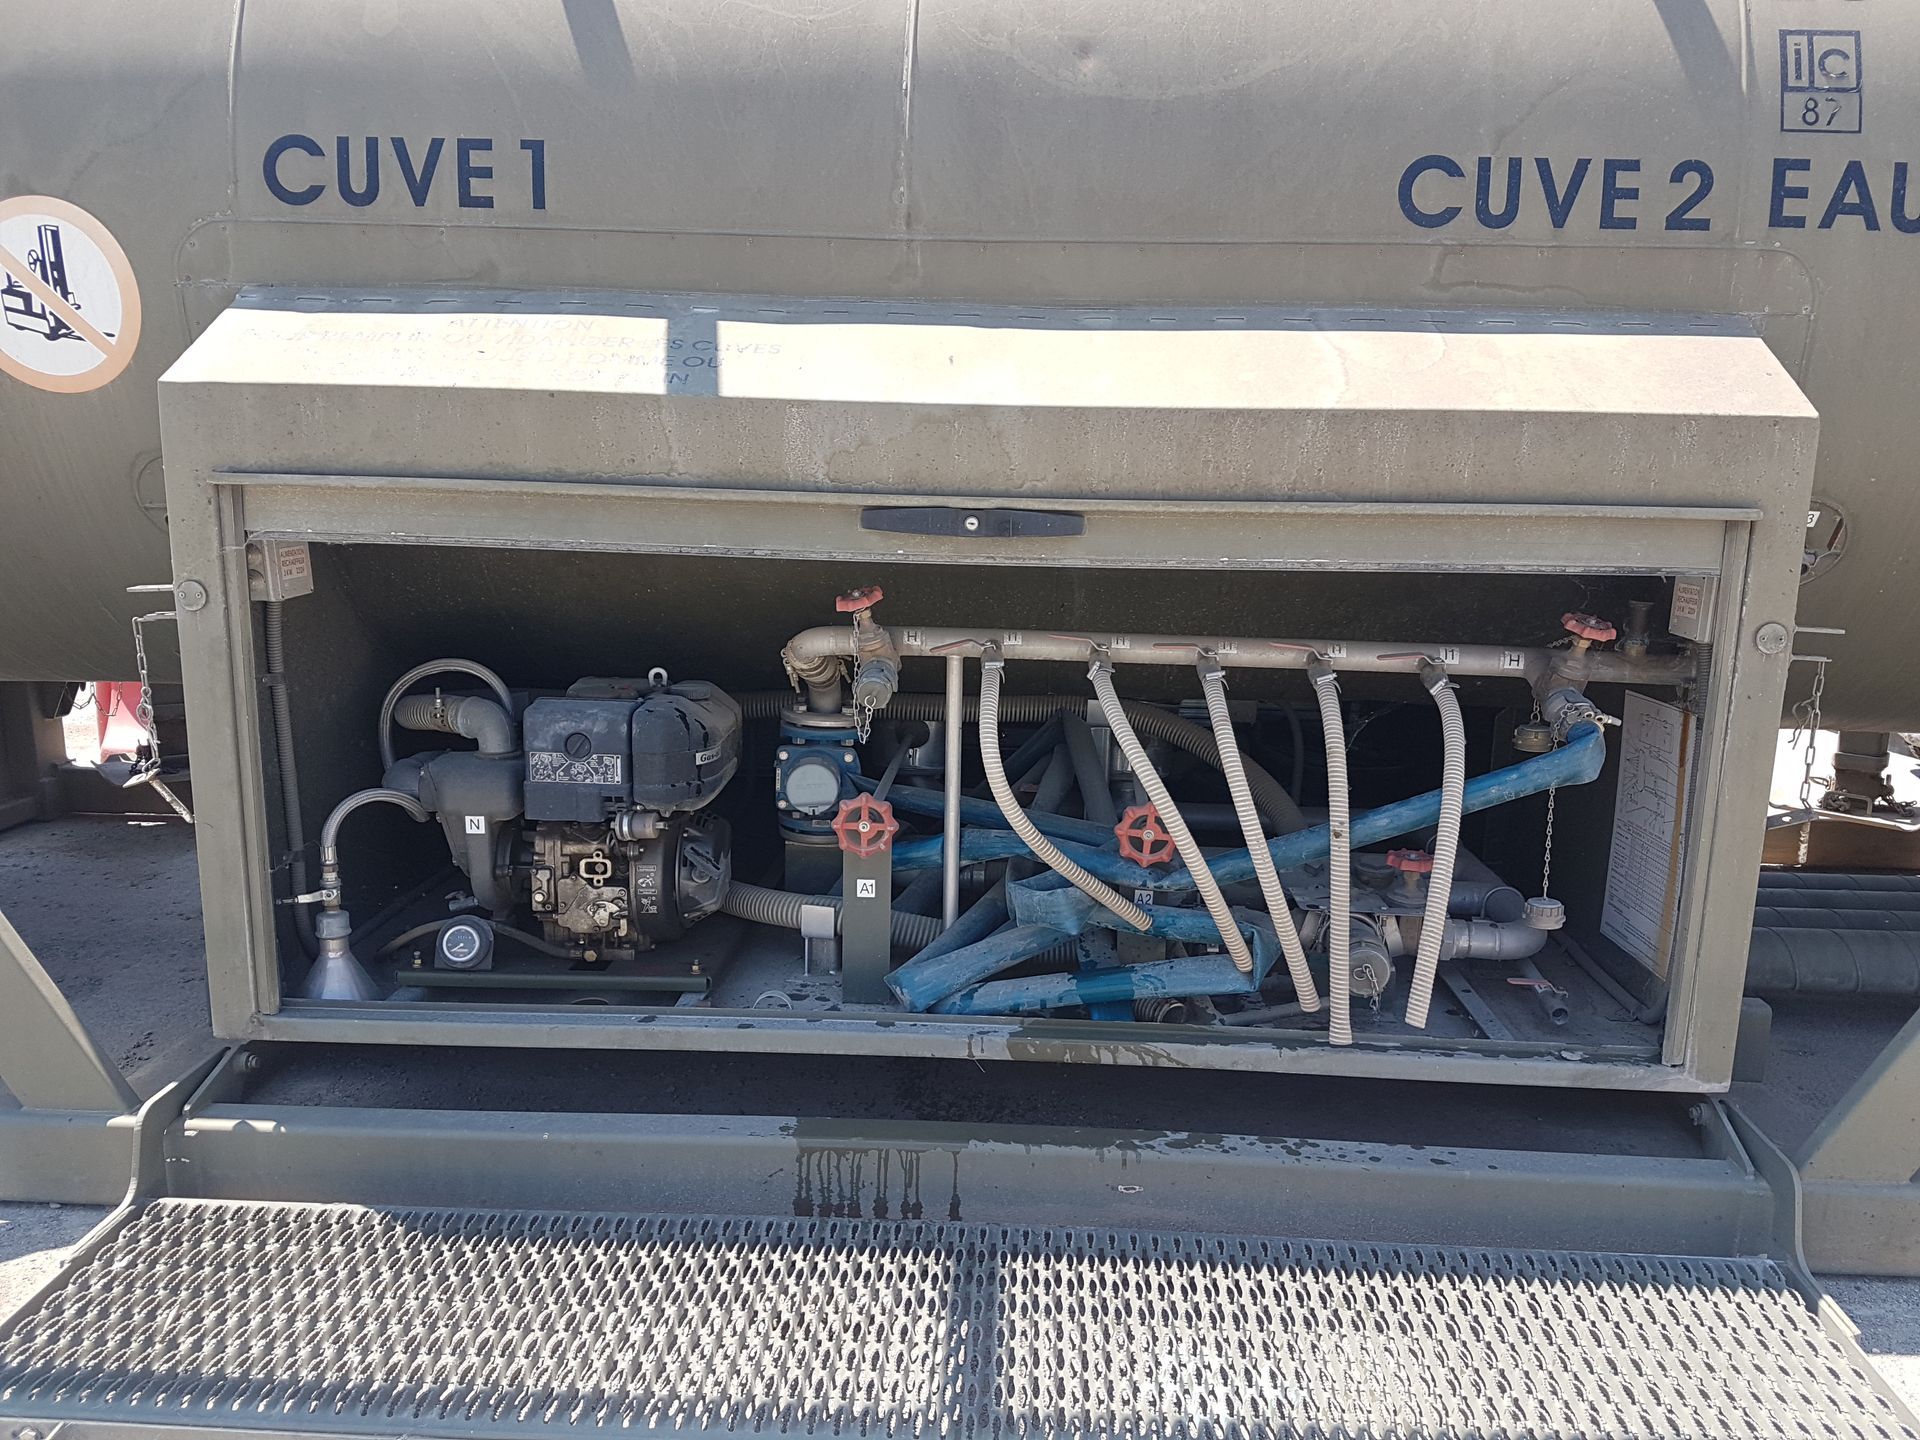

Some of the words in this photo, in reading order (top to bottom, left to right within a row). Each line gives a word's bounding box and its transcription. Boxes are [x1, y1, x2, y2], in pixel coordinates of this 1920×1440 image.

[1801, 97, 1843, 127] 87
[262, 133, 495, 209] CUVE
[519, 138, 547, 210] 1
[1397, 153, 1642, 231] CUVE
[1664, 158, 1715, 232] 2
[1508, 653, 1521, 667] H
[469, 817, 481, 832] N
[858, 881, 875, 895] A1
[1136, 892, 1152, 905] A2
